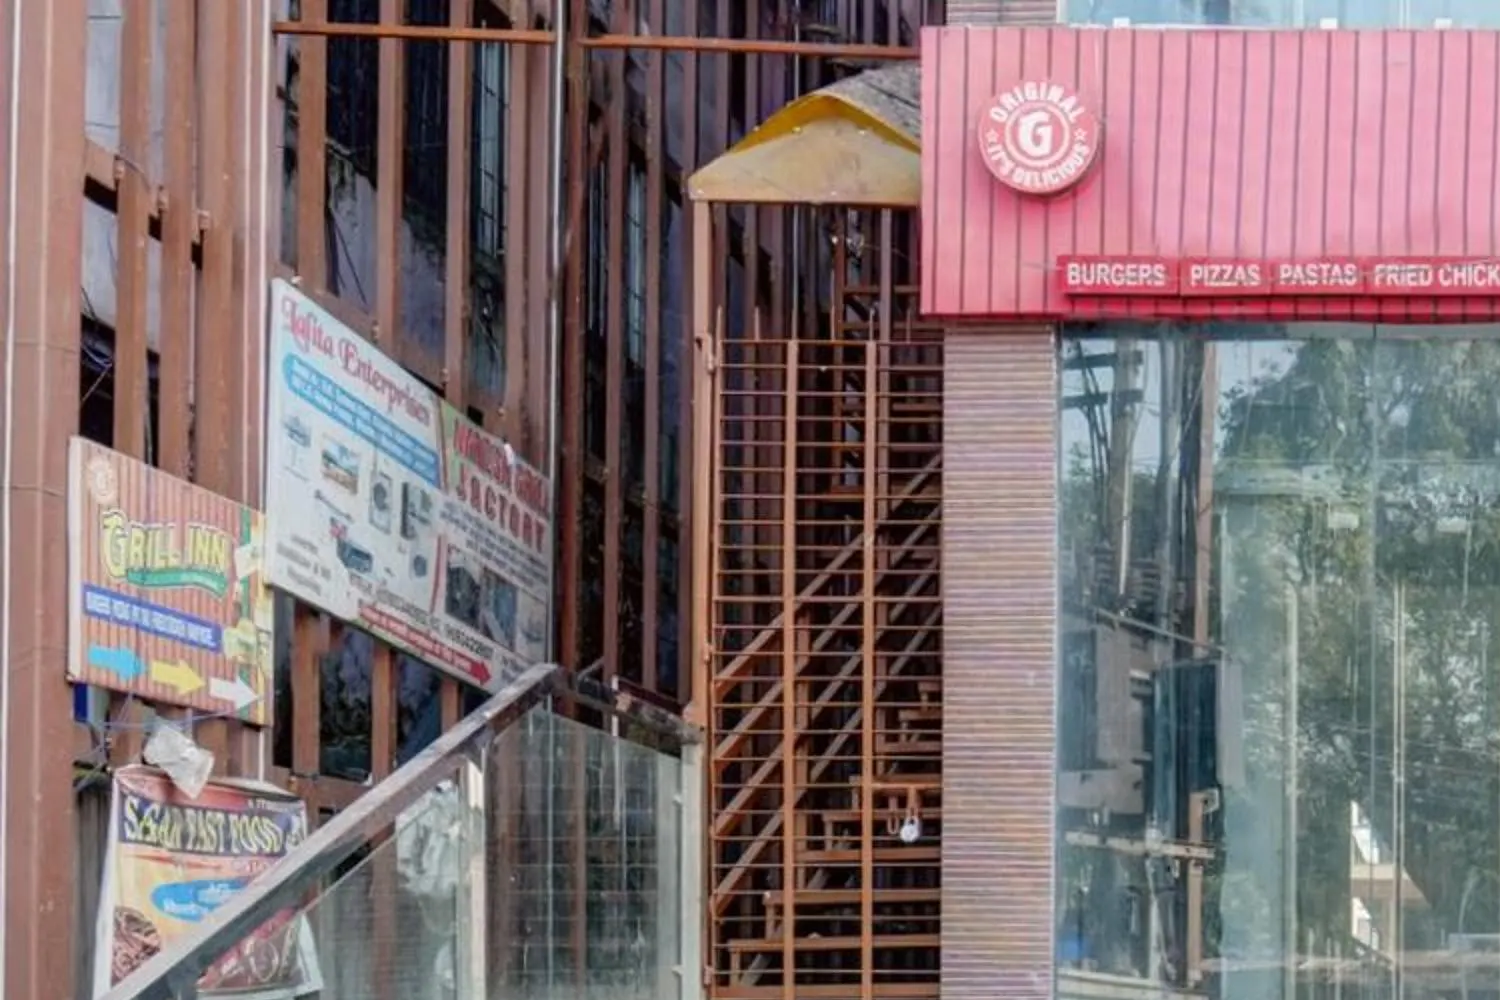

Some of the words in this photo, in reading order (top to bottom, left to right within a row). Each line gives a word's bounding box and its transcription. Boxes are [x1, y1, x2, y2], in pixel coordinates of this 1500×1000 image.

[989, 81, 1085, 123] ORIGINAL
[1018, 111, 1053, 157] G
[1011, 143, 1090, 187] DELICIOUS
[1067, 263, 1166, 286] BURGERS
[1191, 264, 1261, 287] PIZZAS
[1280, 263, 1358, 286] PASTAS
[1374, 263, 1433, 287] FRIED
[101, 508, 181, 580] GRILL
[186, 522, 231, 571] INN
[185, 806, 226, 854] FAST
[230, 813, 283, 854] FOOD
